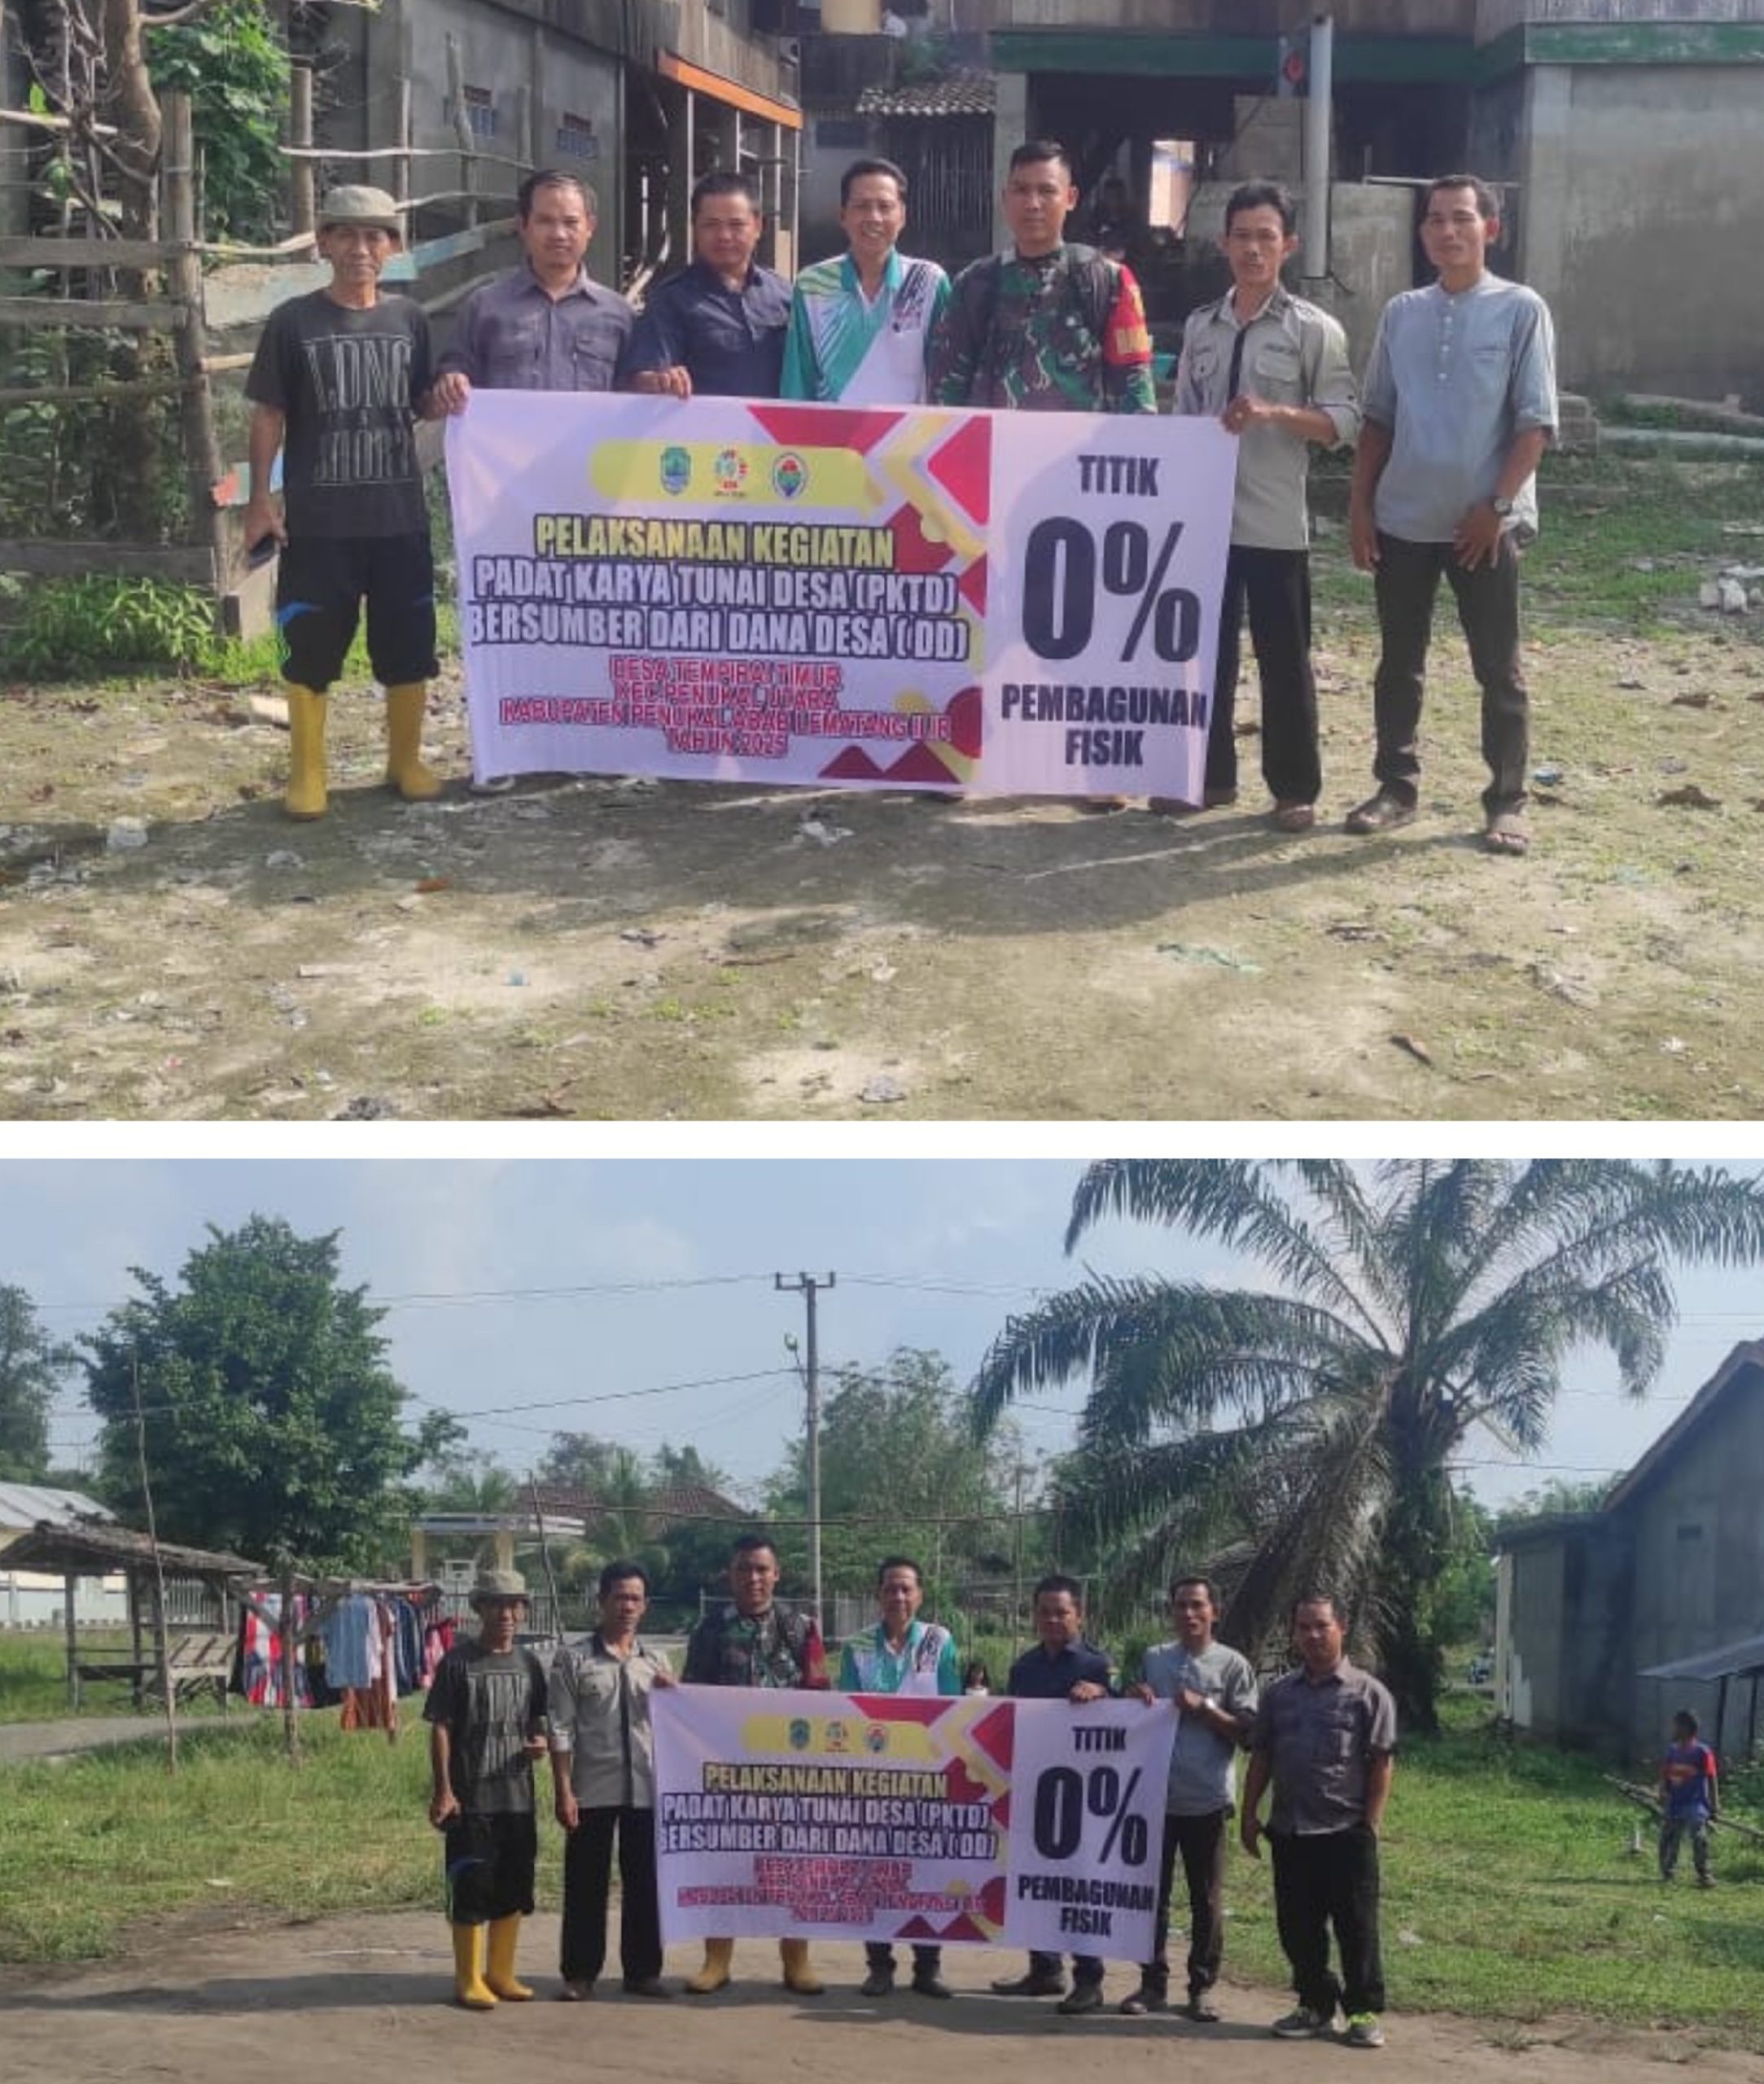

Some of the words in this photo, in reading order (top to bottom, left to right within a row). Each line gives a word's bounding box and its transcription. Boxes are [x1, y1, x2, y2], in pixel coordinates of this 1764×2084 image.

[1078, 455, 1159, 496] TITIK
[535, 514, 746, 562] PELAKSANAAN
[751, 522, 894, 569] KEGIATAN
[475, 555, 567, 601] PADAT
[573, 560, 672, 606] KARYA
[677, 563, 767, 609] TUNAI
[773, 568, 850, 611] DESA
[856, 572, 959, 615] (PKTD)
[1022, 516, 1201, 662] 0%
[469, 601, 646, 649] BERSUMBER
[648, 608, 720, 652] DARI
[729, 611, 808, 655] DANA
[814, 615, 891, 658] DESA
[611, 655, 668, 681] DESA
[777, 661, 842, 688] TIMUR
[501, 697, 625, 726] KABUPATEN
[630, 700, 732, 731] PENUKAL
[768, 686, 839, 713] UTARA
[1002, 684, 1207, 731] PEMBAGUNAN
[669, 727, 734, 755] TAHUN
[1065, 729, 1143, 766] FISIK
[1072, 1726, 1126, 1752] TITIK
[703, 1762, 847, 1796] PELAKSANAAN
[852, 1768, 948, 1800] KEGIATAN
[663, 1793, 727, 1822] PADAT
[730, 1794, 796, 1823] KARYA
[799, 1796, 860, 1825] TUNAI
[864, 1798, 916, 1827] DESA
[921, 1801, 990, 1830] (PKTD)
[1034, 1766, 1147, 1866] 0%
[780, 1825, 829, 1854] DARI
[834, 1827, 888, 1857] DANA
[893, 1830, 944, 1859] DESA
[1018, 1874, 1155, 1911] PEMBAGUNAN
[1060, 1907, 1111, 1936] FISIK
